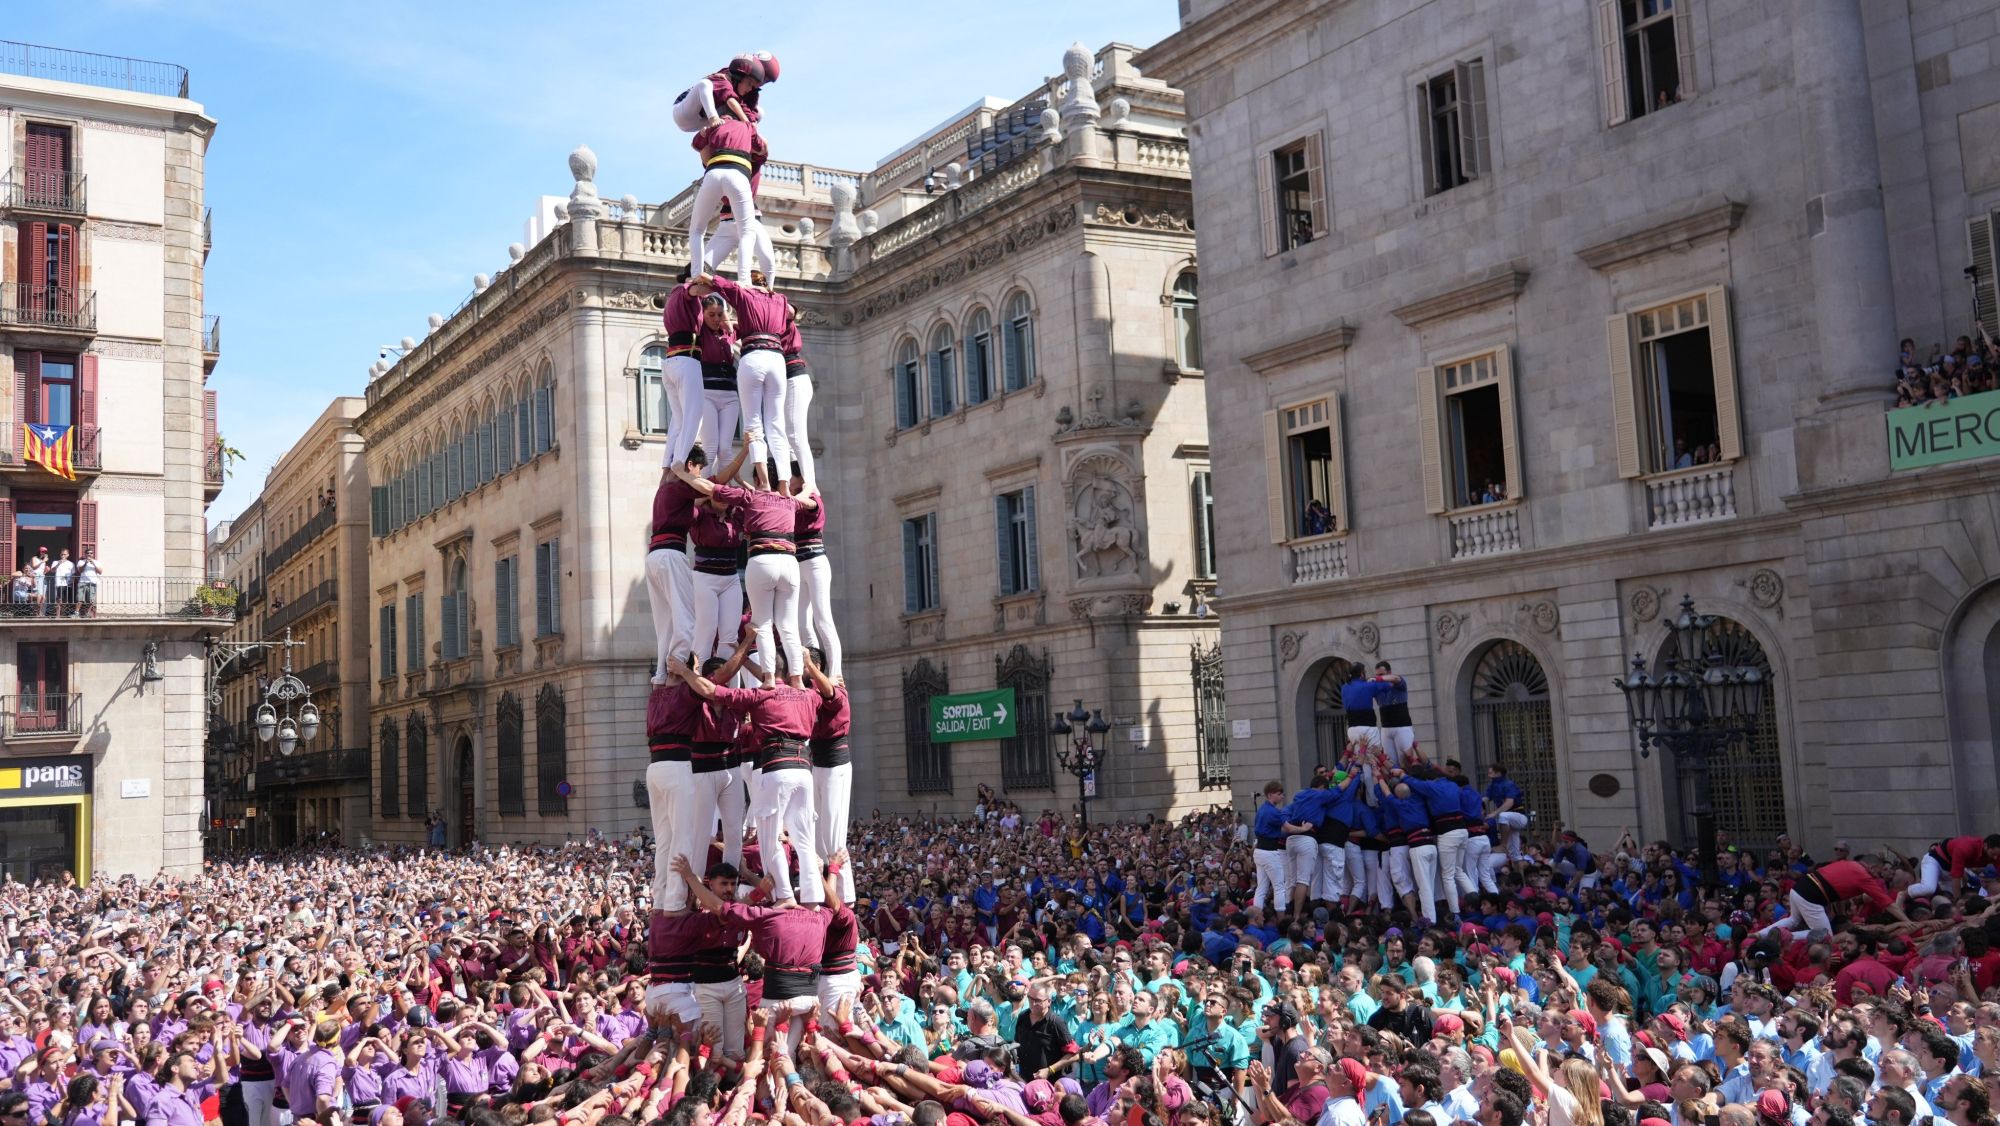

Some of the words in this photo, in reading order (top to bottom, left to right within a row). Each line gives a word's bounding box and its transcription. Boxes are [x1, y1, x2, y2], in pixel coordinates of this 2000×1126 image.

[943, 703, 983, 719] SORTIDA
[936, 719, 966, 734] SALIDA
[966, 718, 971, 733] /
[972, 717, 992, 731] EXIT
[25, 764, 83, 788] pans
